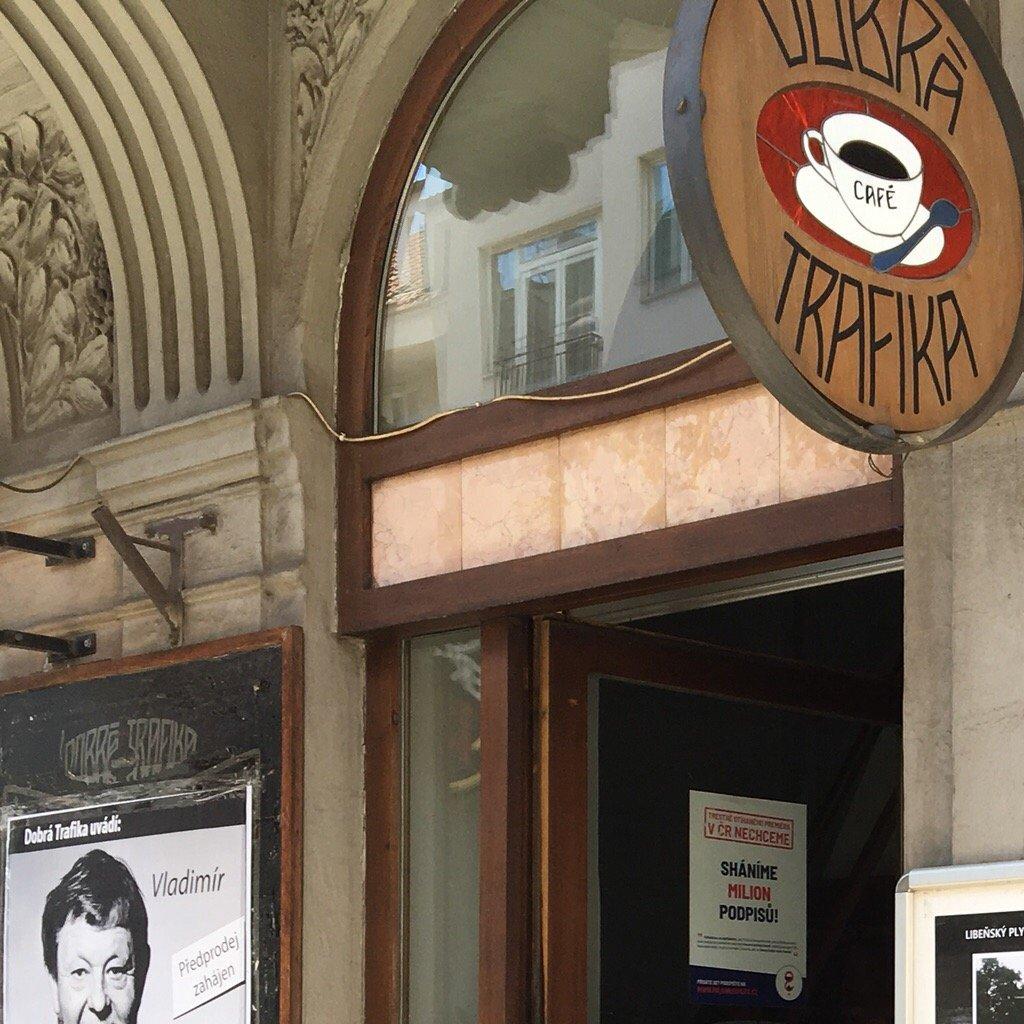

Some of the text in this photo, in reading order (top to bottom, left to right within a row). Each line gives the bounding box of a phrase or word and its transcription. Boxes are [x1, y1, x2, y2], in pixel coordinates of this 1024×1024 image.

[853, 181, 898, 210] CAFÉ
[774, 231, 979, 415] TRAFIKA
[24, 814, 122, 845] Dobrá Trafika uvádí:
[707, 821, 790, 846] V ČR NECHCEME
[152, 866, 226, 898] Vladimír
[720, 859, 778, 880] SHÁNÍME
[727, 883, 771, 902] MILION
[719, 903, 779, 923] PODPISŮ!
[965, 924, 1008, 940] LIBEŇSKÝ
[178, 931, 240, 978] Předprodej
[193, 965, 236, 997] zahájen
